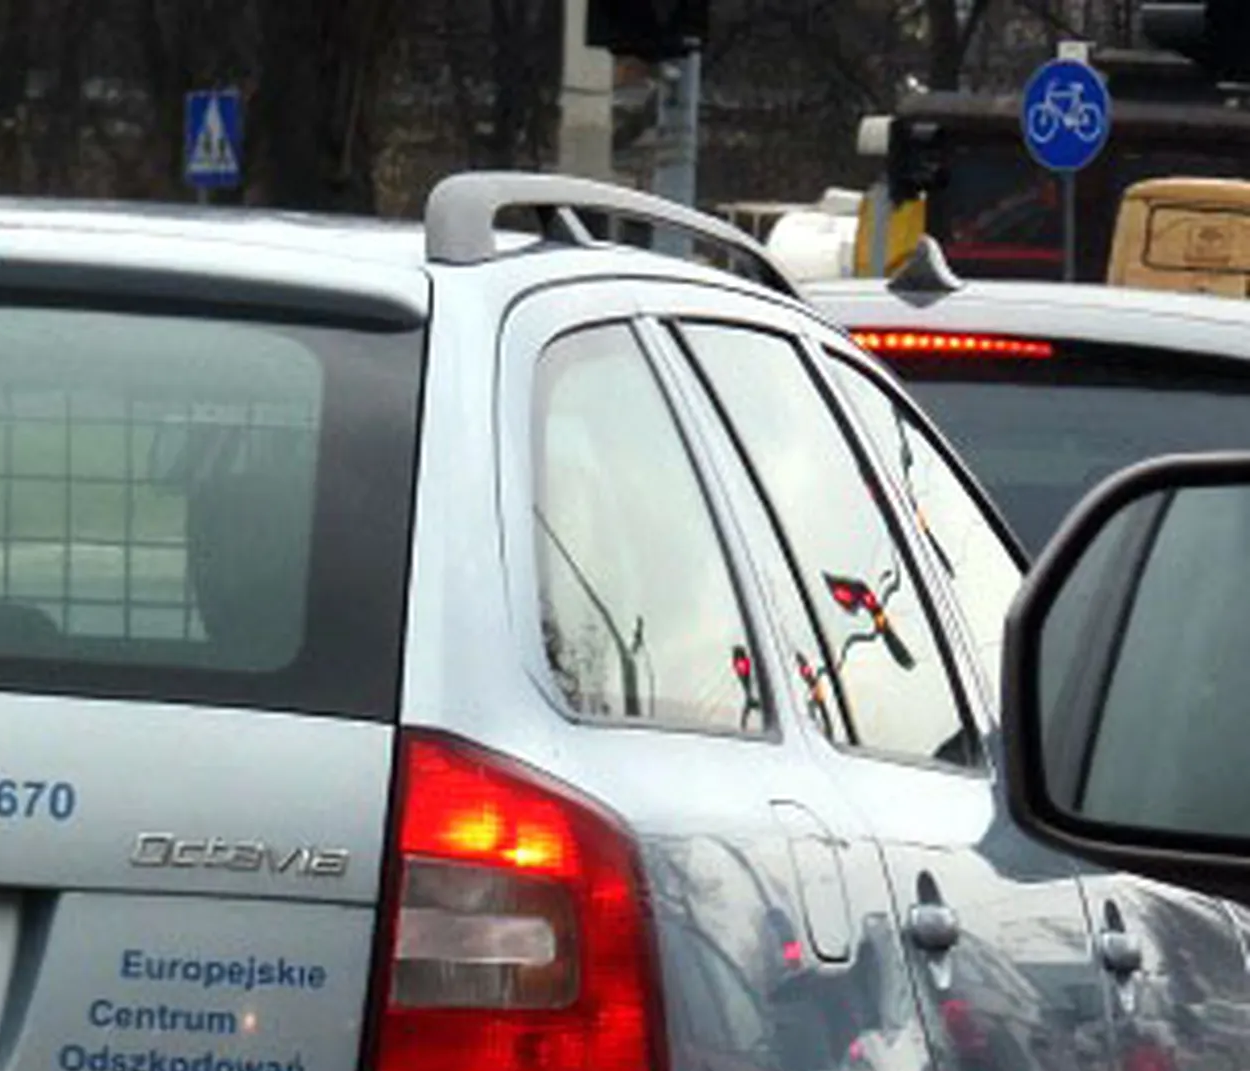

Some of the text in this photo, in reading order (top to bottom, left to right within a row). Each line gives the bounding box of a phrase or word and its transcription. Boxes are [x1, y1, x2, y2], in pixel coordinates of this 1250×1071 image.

[129, 832, 349, 877] Octavia
[120, 949, 327, 991] Europejskie
[87, 998, 237, 1034] Centrum
